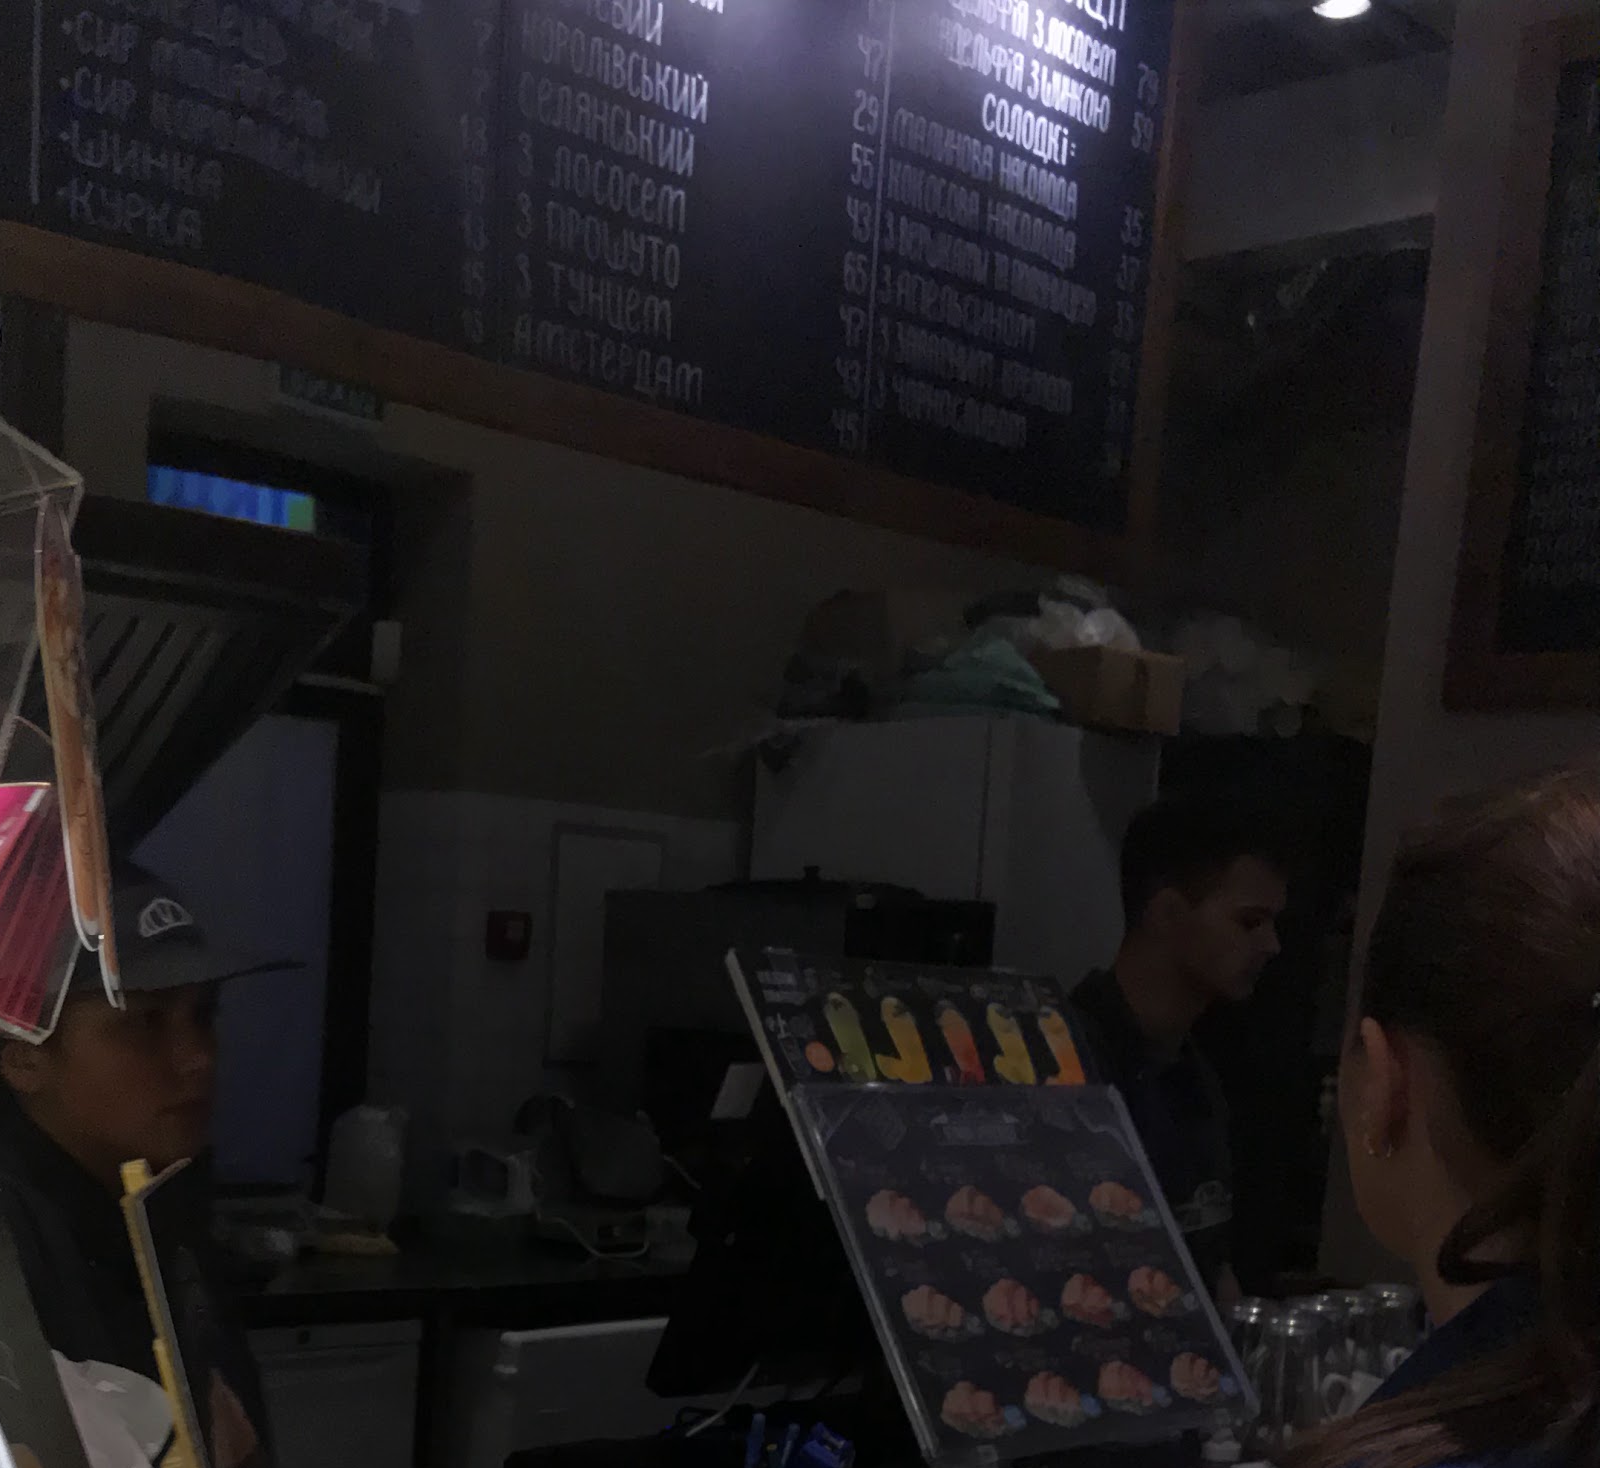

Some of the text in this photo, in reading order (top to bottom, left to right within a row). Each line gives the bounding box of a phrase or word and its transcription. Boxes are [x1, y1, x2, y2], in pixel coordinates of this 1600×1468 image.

[853, 88, 879, 136] 29
[851, 142, 875, 190] 55
[846, 195, 873, 243] 43
[546, 201, 680, 290] ПРОШУТО
[843, 250, 867, 295] 65
